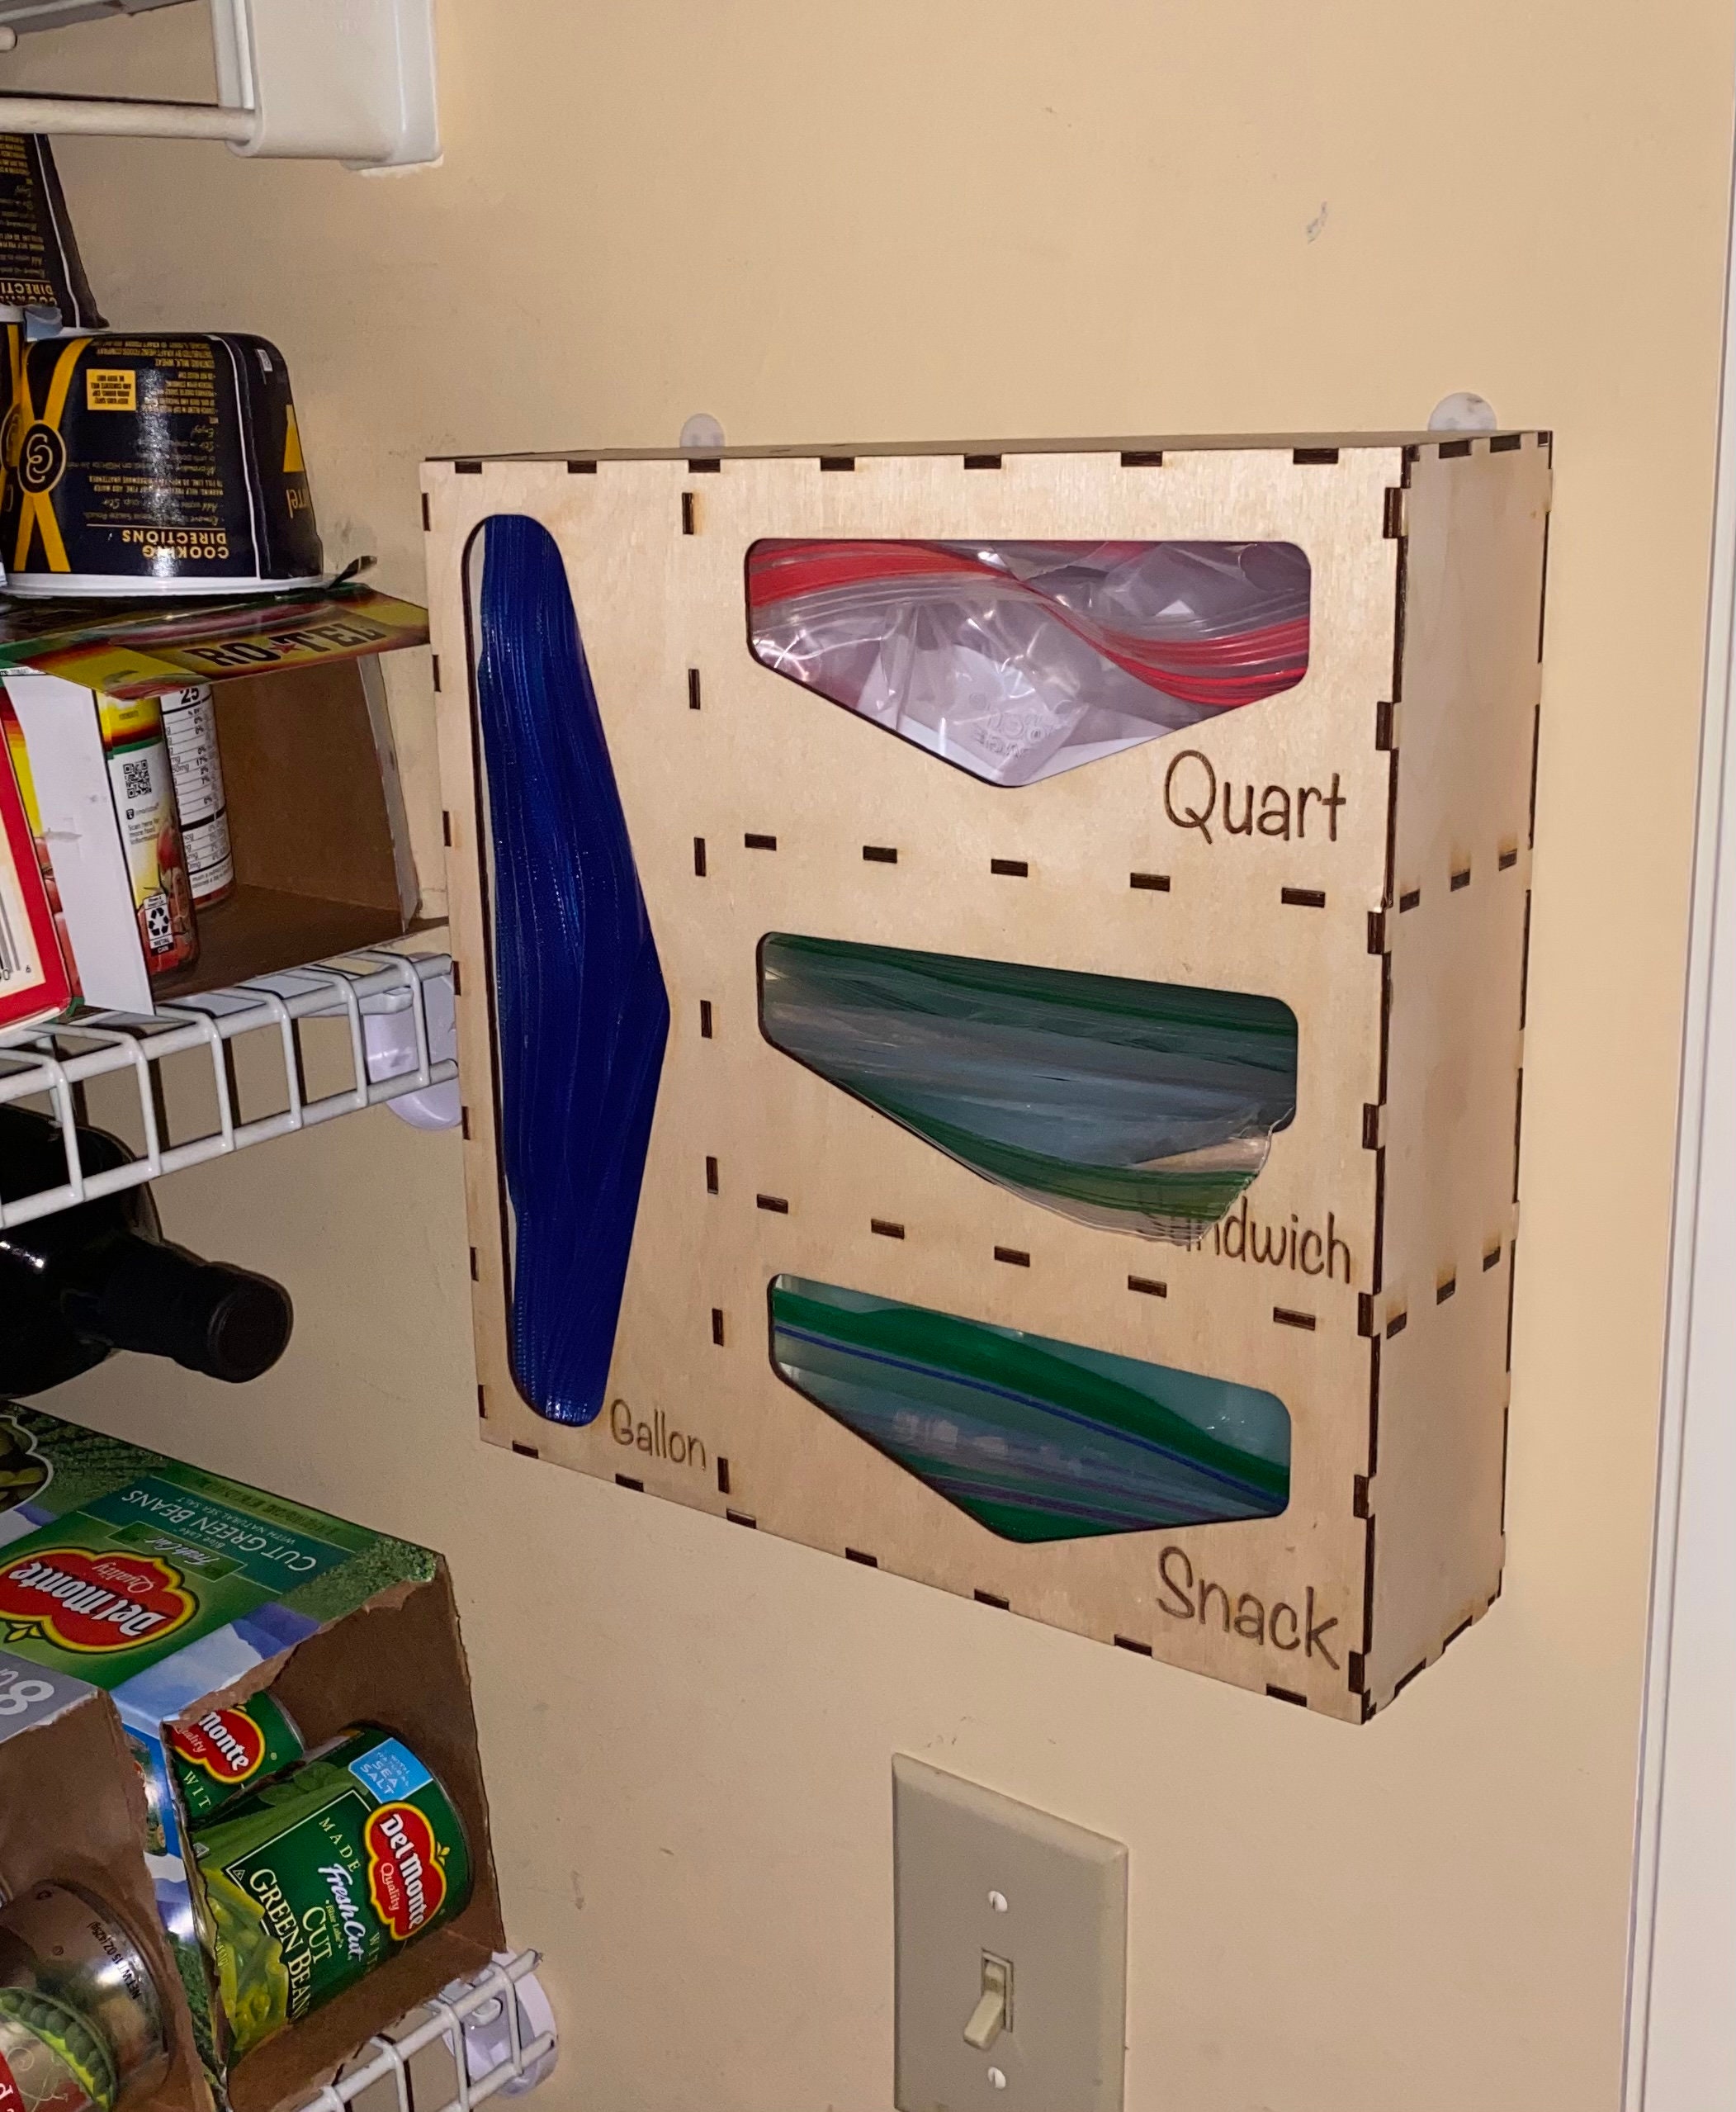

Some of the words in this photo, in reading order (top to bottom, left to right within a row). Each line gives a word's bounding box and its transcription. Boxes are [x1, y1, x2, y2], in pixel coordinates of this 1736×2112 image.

[121, 529, 226, 545] DIRECTIONS
[142, 544, 229, 560] COOKG
[1164, 750, 1346, 844] Quart
[1137, 1195, 1350, 1284] ndwich
[611, 1399, 706, 1470] Gallon
[121, 1489, 196, 1524] BEANS
[188, 1516, 267, 1552] GREEN
[260, 1546, 318, 1572] CUT
[8, 1561, 116, 1615] Monte
[90, 1598, 167, 1636] Del
[91, 1561, 154, 1593] Quality
[1156, 1546, 1341, 1670] Snack
[174, 1726, 206, 1753] uality
[360, 1764, 395, 1795] SALT
[371, 1760, 398, 1789] SEA
[319, 1816, 362, 1873] MADE
[379, 1813, 414, 1859] Del
[399, 1851, 428, 1930] Monte
[249, 1868, 305, 1953] GREEN
[380, 1862, 400, 1911] Quality
[112, 1953, 124, 1965] 15
[302, 1906, 333, 1964] CUT
